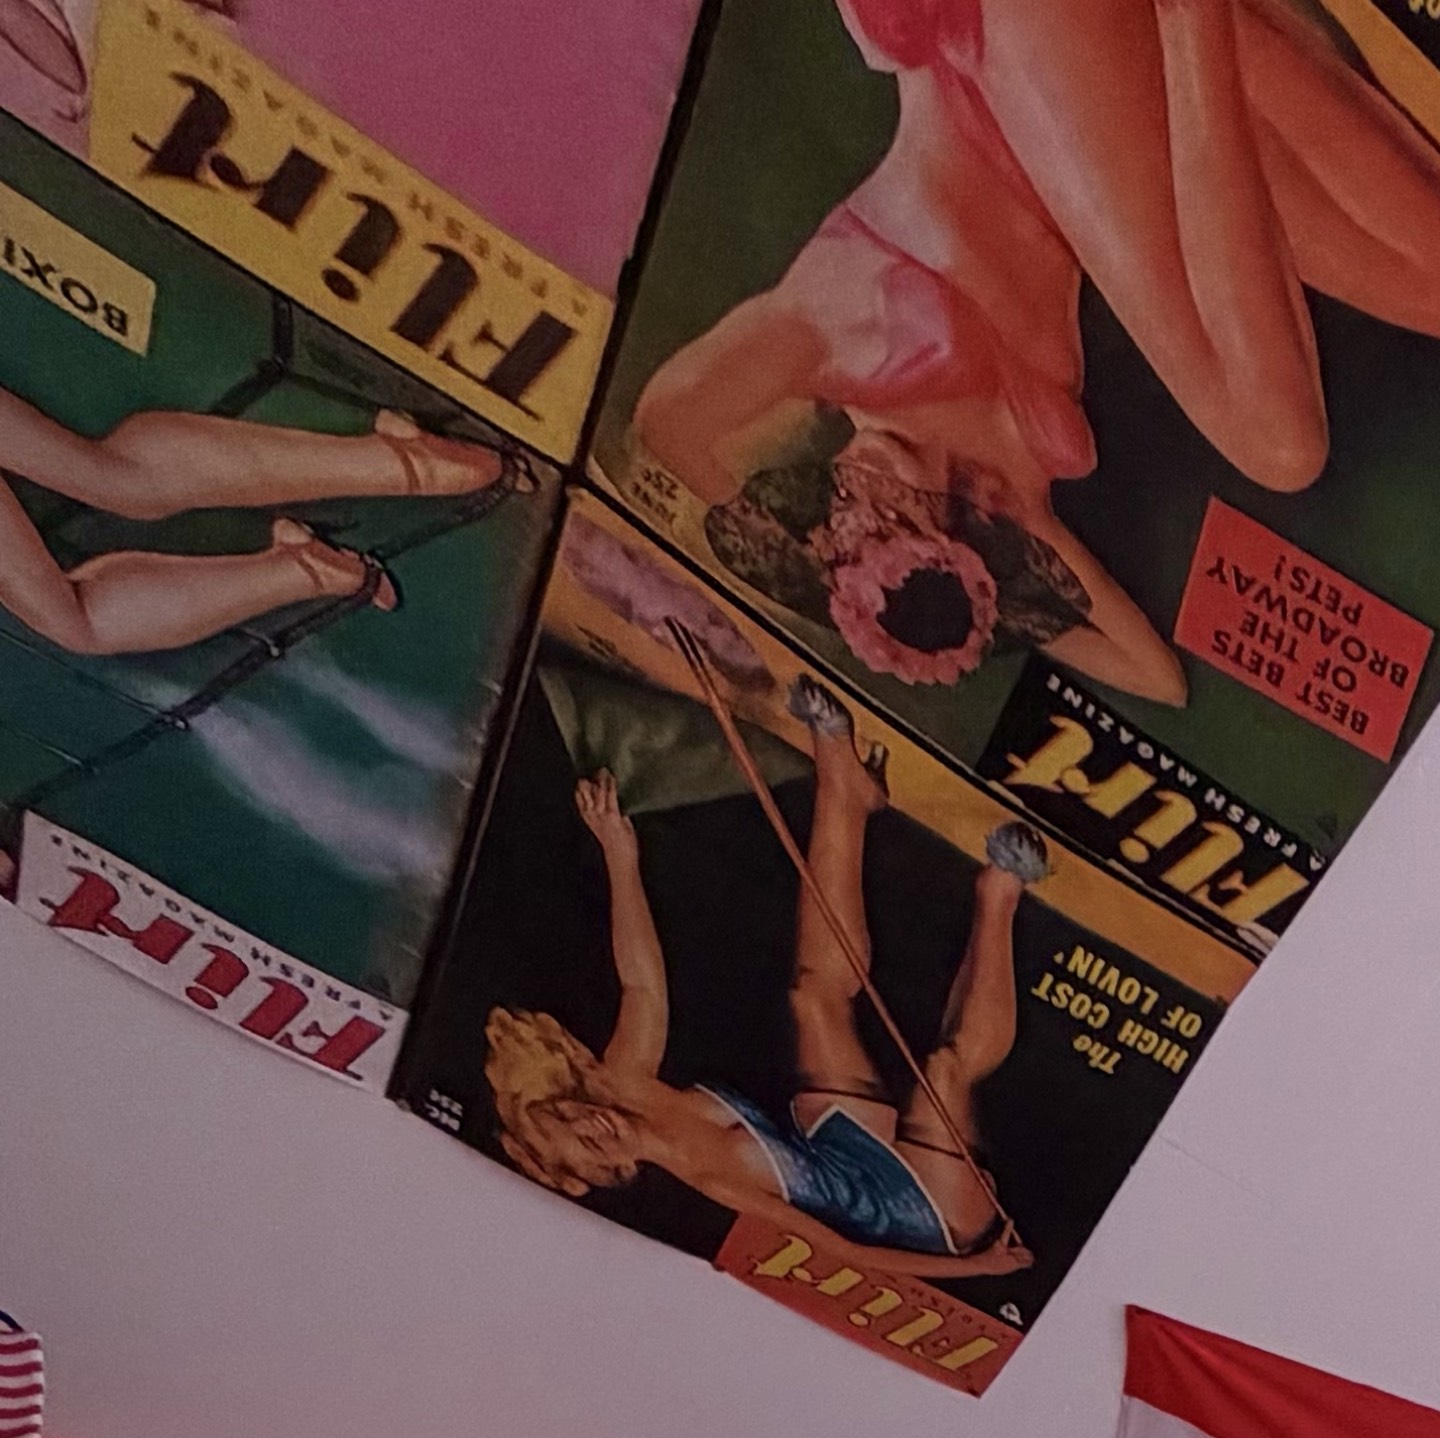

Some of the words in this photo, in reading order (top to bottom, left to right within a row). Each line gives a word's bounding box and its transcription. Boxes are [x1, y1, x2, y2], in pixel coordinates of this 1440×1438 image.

[132, 71, 580, 423] Flirt
[1206, 554, 1411, 690] BROADWAY
[1273, 555, 1366, 626] PETS!
[1211, 629, 1286, 690] BETS
[1238, 610, 1301, 664] THE
[1298, 682, 1371, 736] BEST
[1312, 657, 1358, 694] OF
[1046, 672, 1198, 788] MAGAZINE
[1002, 714, 1311, 924] Flirt
[1204, 786, 1298, 858] FRESH
[50, 833, 236, 944] MAGAZINE
[39, 865, 386, 1082] Flirt
[250, 946, 364, 1010] FRESH
[1031, 971, 1111, 1031] COST
[1072, 1033, 1124, 1075] The
[1117, 1018, 1191, 1074] HIGH
[1163, 1002, 1204, 1041] OF
[750, 1232, 1002, 1372] Flirt
